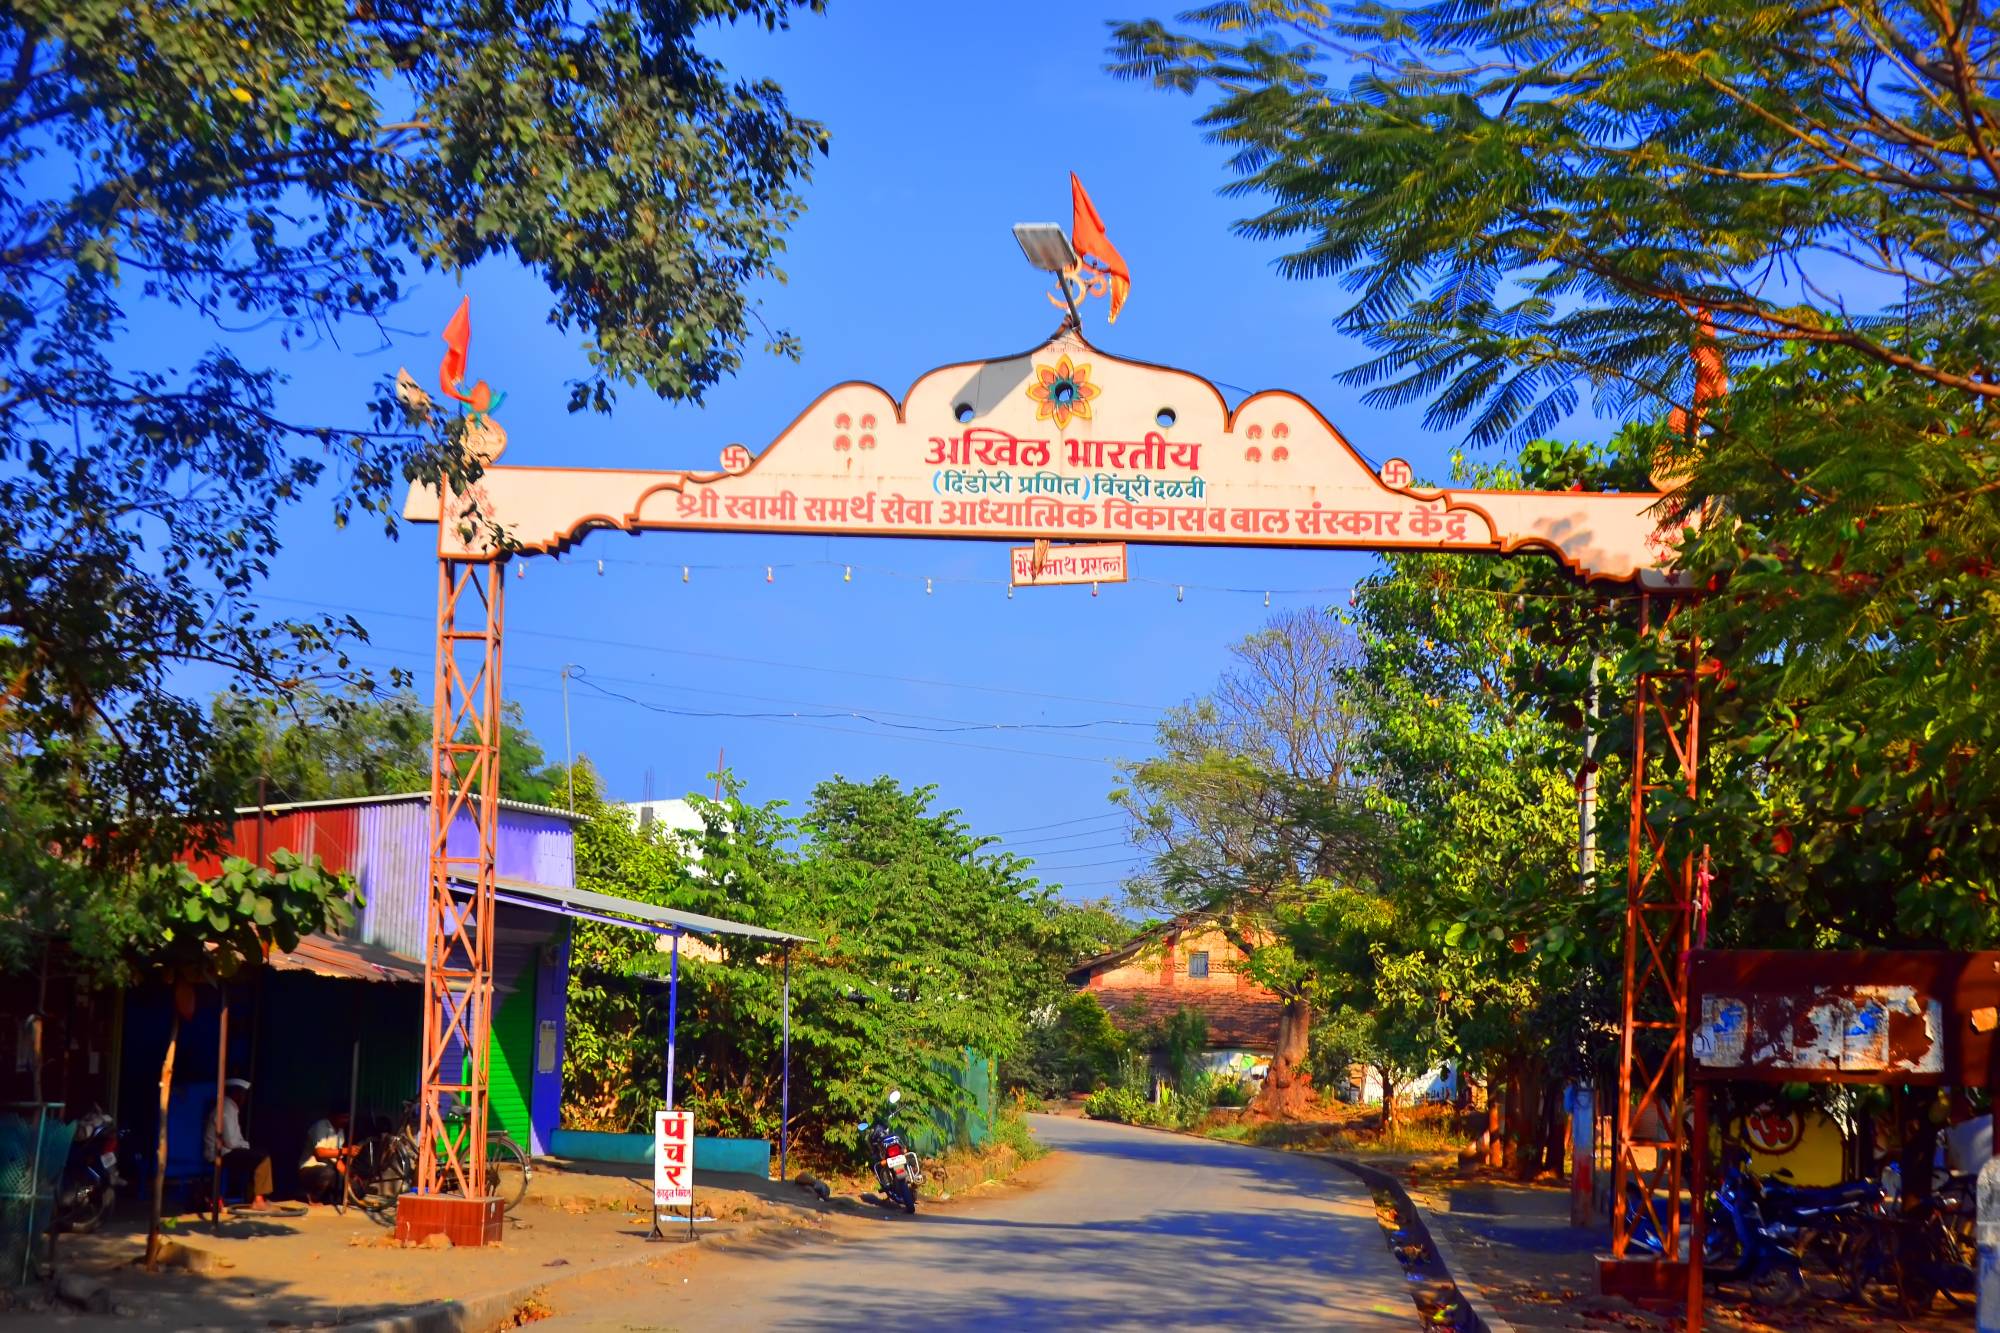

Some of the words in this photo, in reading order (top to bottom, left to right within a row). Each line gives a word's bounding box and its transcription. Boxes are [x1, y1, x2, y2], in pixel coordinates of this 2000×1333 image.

[925, 427, 1050, 467] अखिल
[1065, 431, 1201, 470] भारतीय
[1154, 476, 1205, 498] दळवी
[676, 488, 719, 519] श्री
[725, 490, 798, 521] स्वामी
[804, 492, 876, 523] समर्थ
[881, 493, 933, 525] सेवा
[939, 496, 1097, 529] आध्यात्मिक
[1103, 499, 1206, 532] विकास
[1230, 507, 1290, 534] बाल
[1295, 502, 1402, 536] संस्कार
[1408, 504, 1467, 541] केंद्र
[662, 1112, 687, 1187] पंचर
